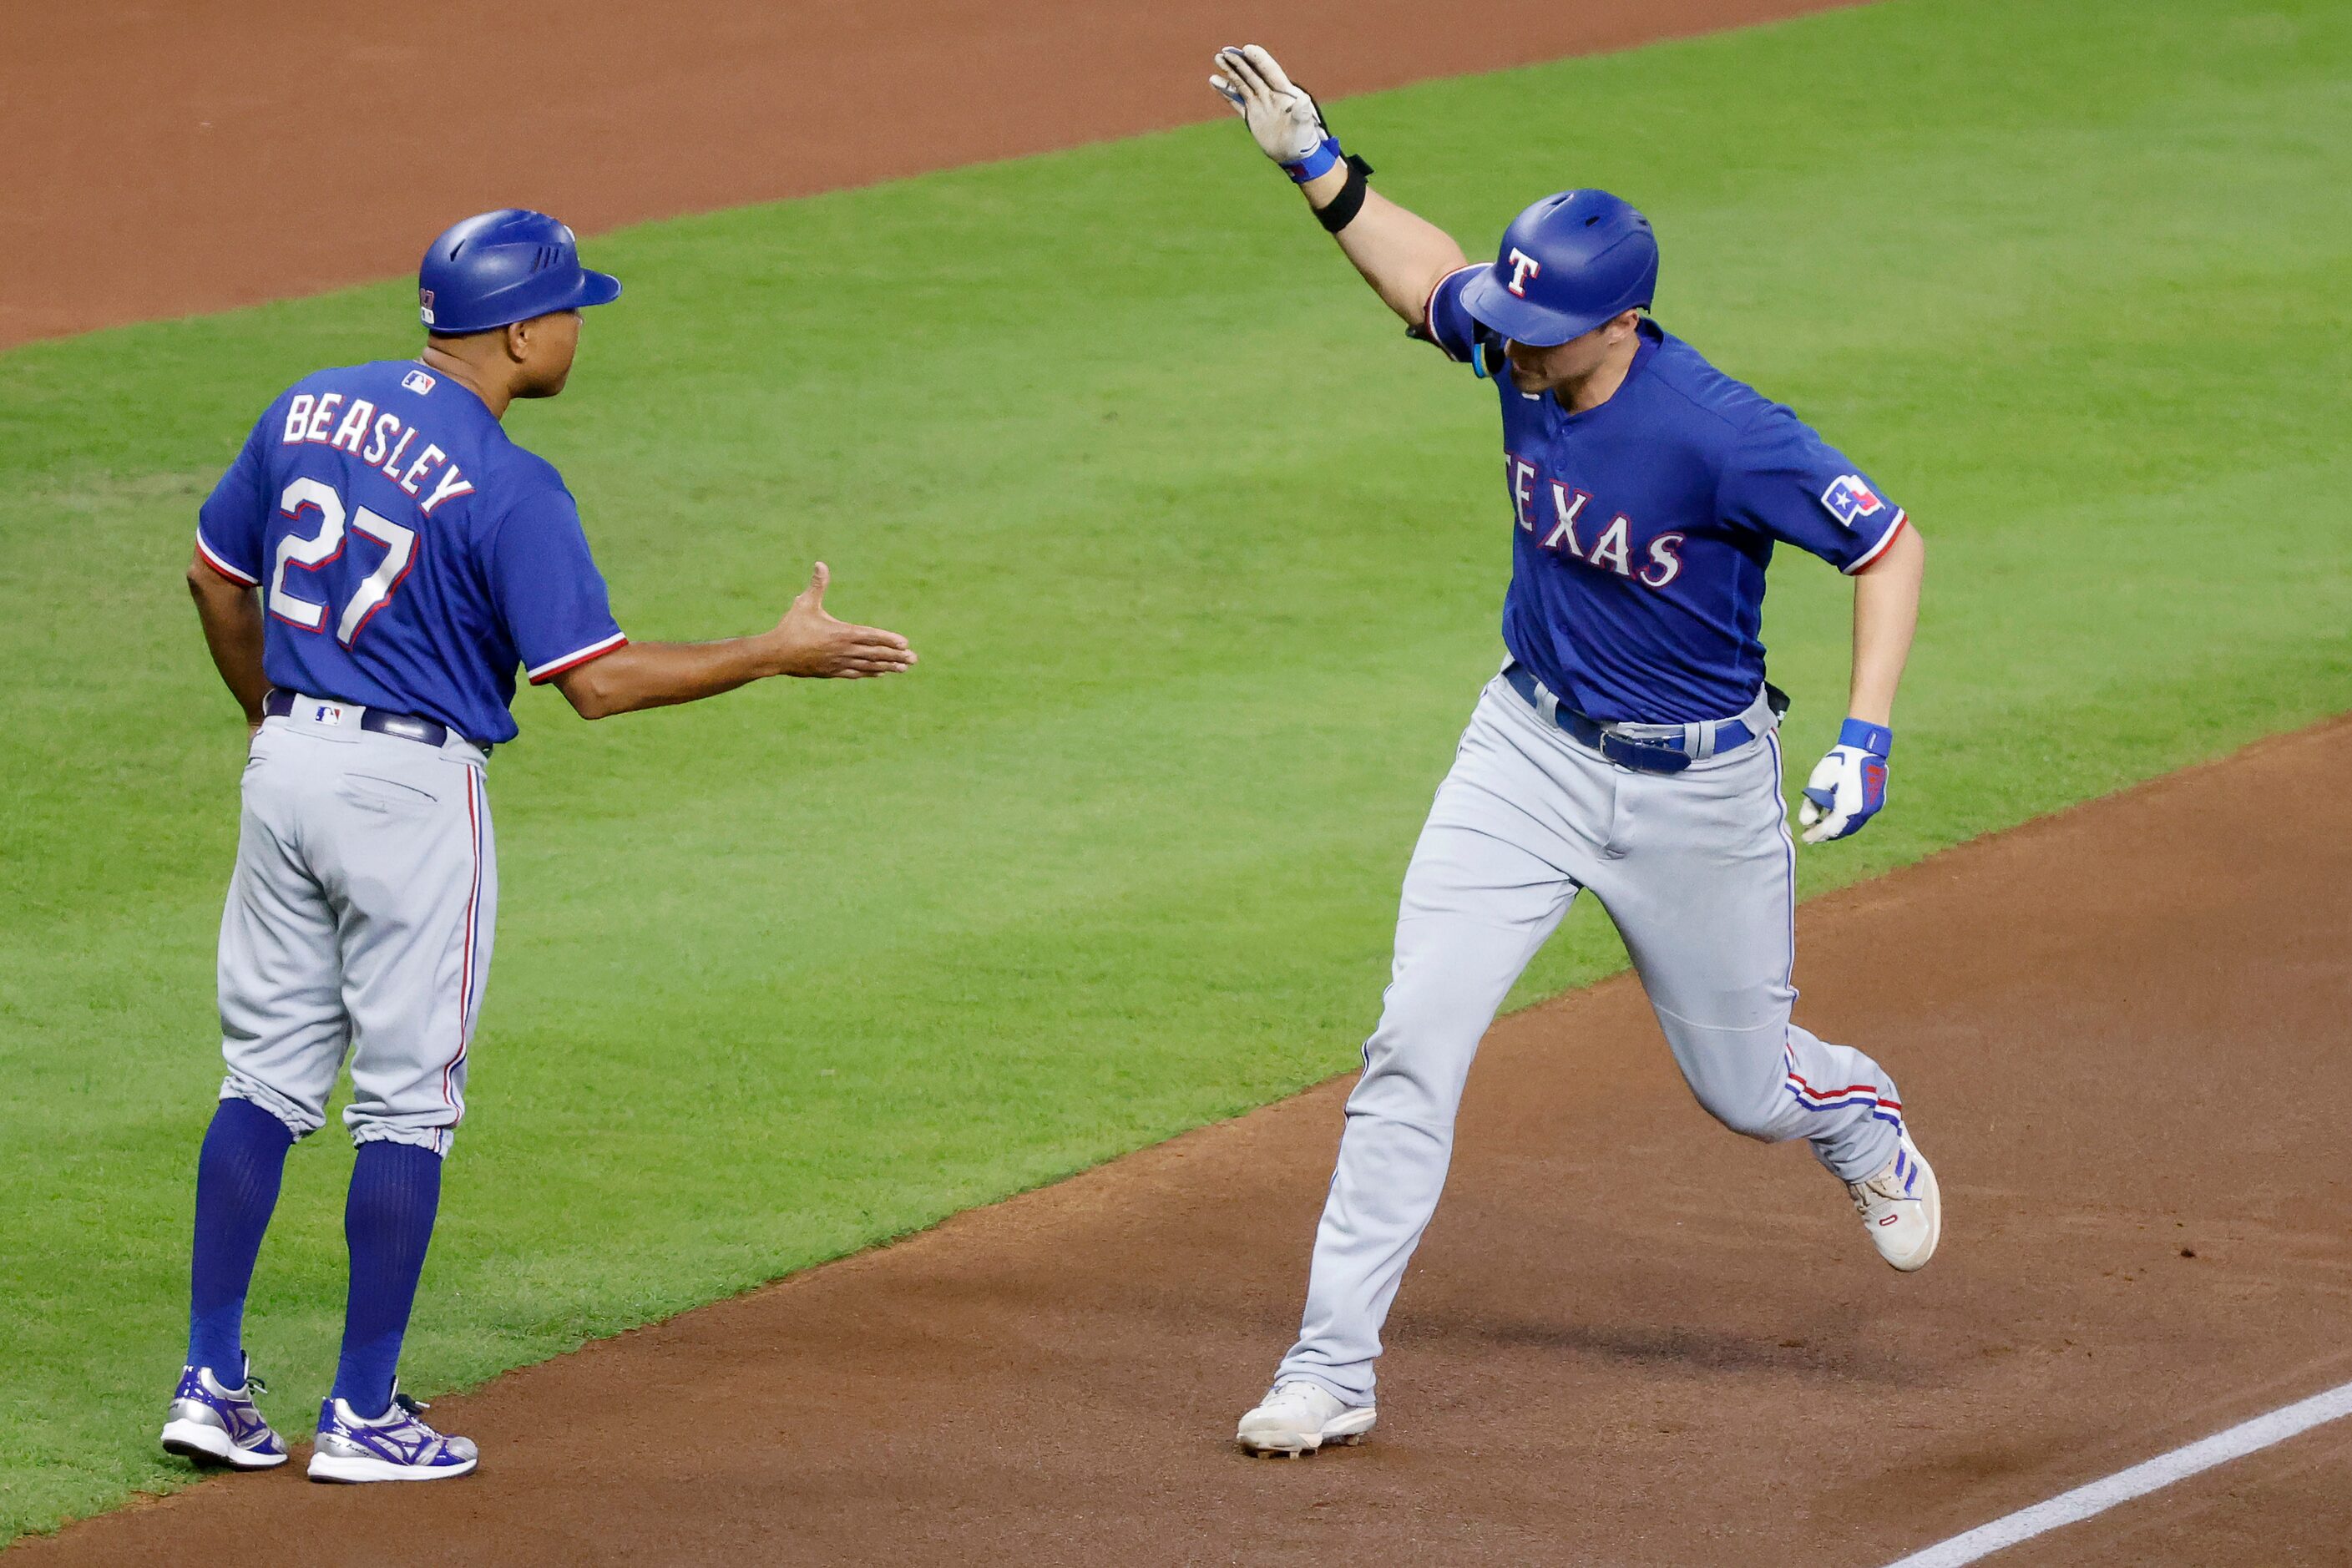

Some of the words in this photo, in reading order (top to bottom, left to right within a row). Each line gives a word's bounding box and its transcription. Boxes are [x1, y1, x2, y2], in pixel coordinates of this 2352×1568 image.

[1508, 246, 1540, 299] T
[282, 392, 475, 518] BEASLEY
[1505, 451, 1687, 589] EXAS
[269, 476, 421, 652] 27
